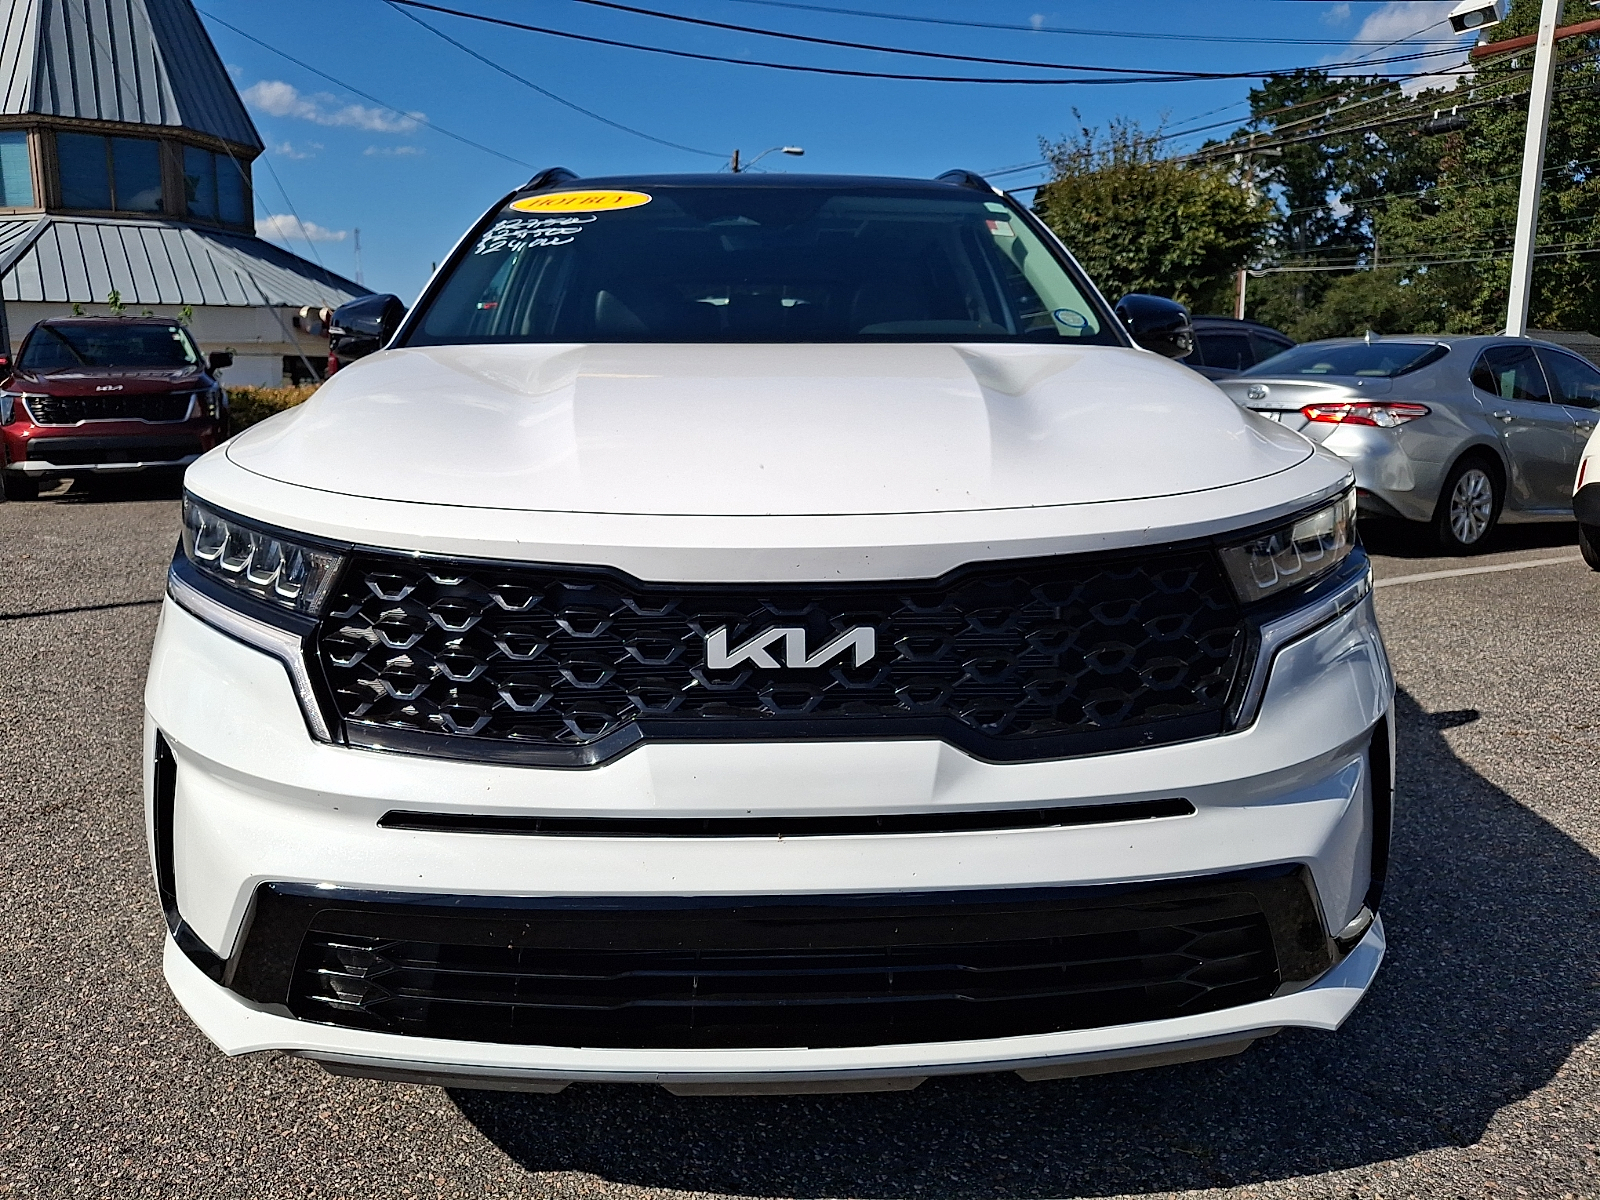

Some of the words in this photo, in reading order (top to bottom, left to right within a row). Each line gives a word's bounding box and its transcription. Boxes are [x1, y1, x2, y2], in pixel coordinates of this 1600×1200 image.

[528, 197, 578, 207] HOT
[580, 195, 630, 204] BUY
[706, 626, 876, 669] KIA
